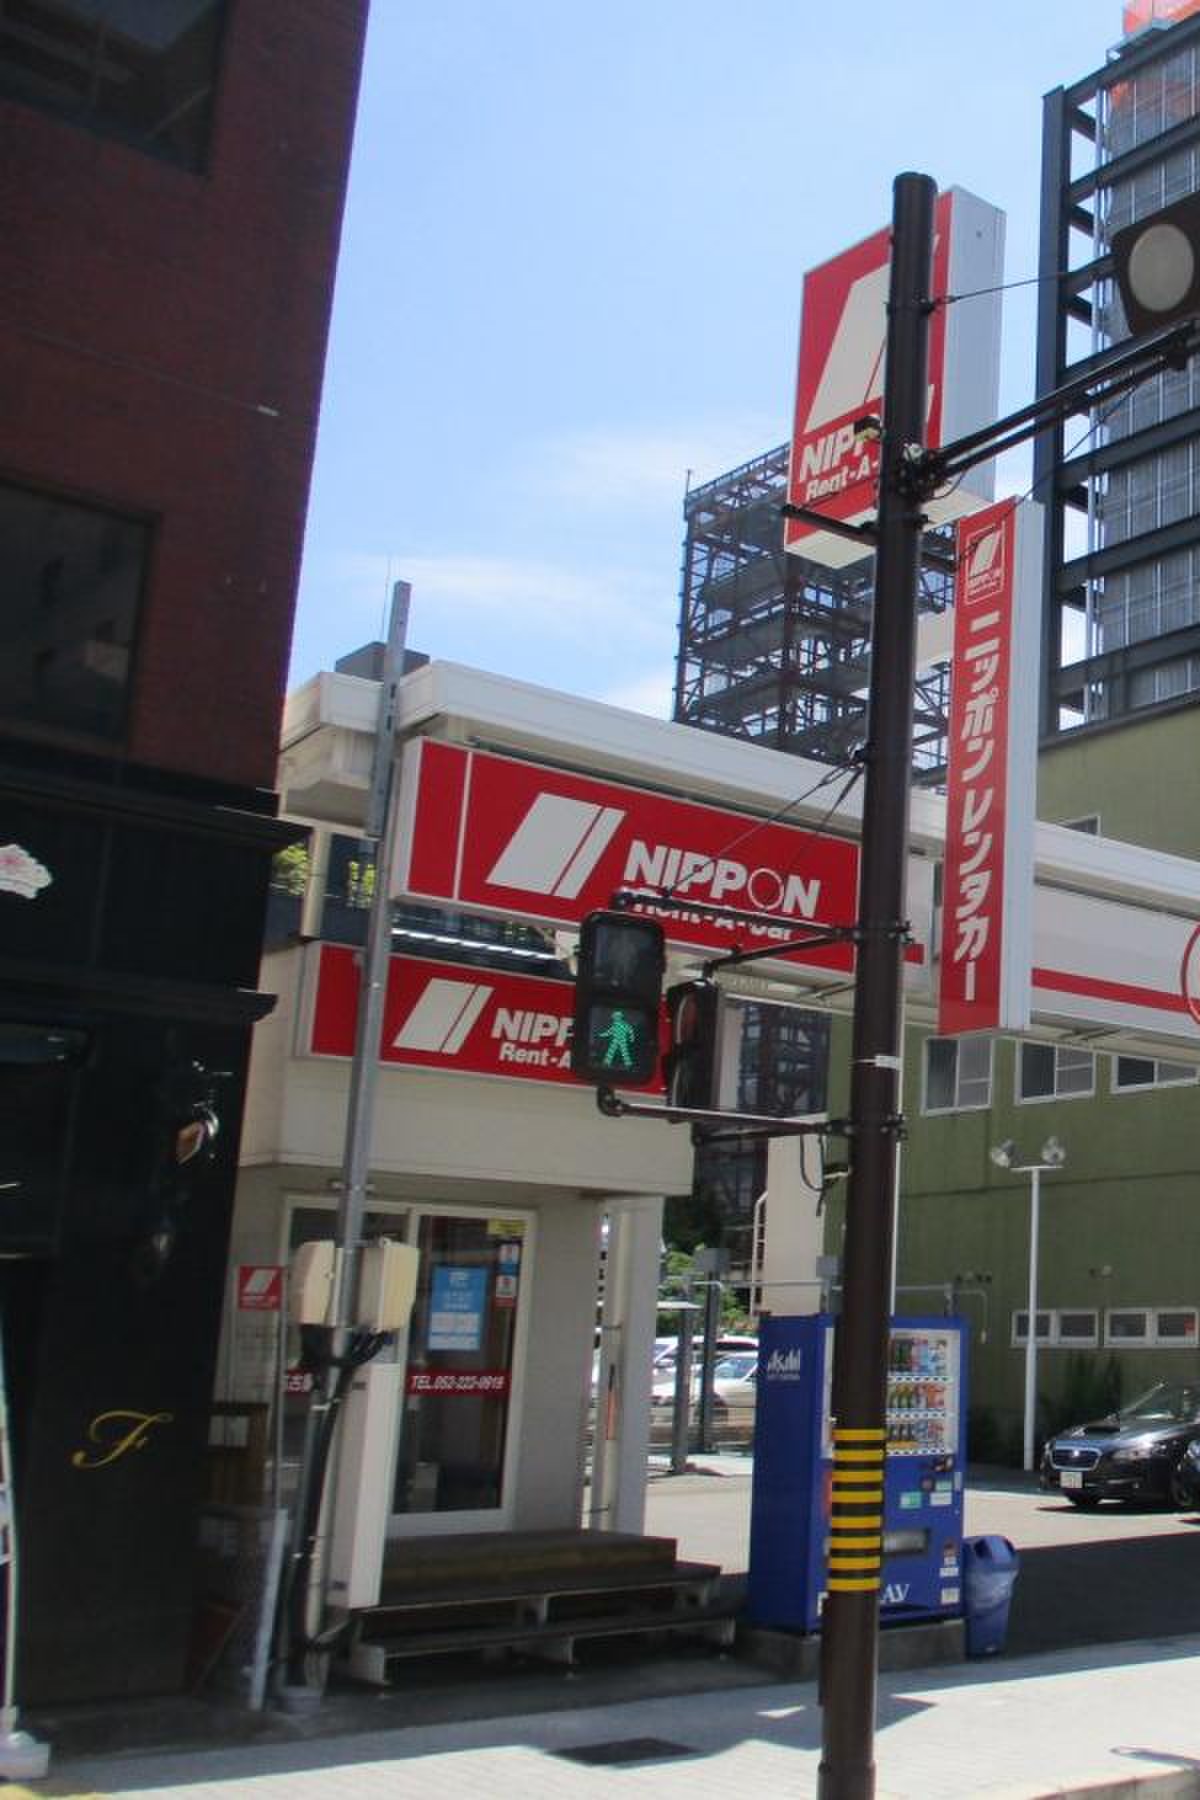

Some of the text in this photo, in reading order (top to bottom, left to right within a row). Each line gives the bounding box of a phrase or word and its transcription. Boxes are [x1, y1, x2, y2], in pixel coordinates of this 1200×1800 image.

[953, 610, 1000, 1001] ニッポンレンタカー
[622, 839, 821, 919] NIPPON
[491, 1007, 576, 1047] NIPP
